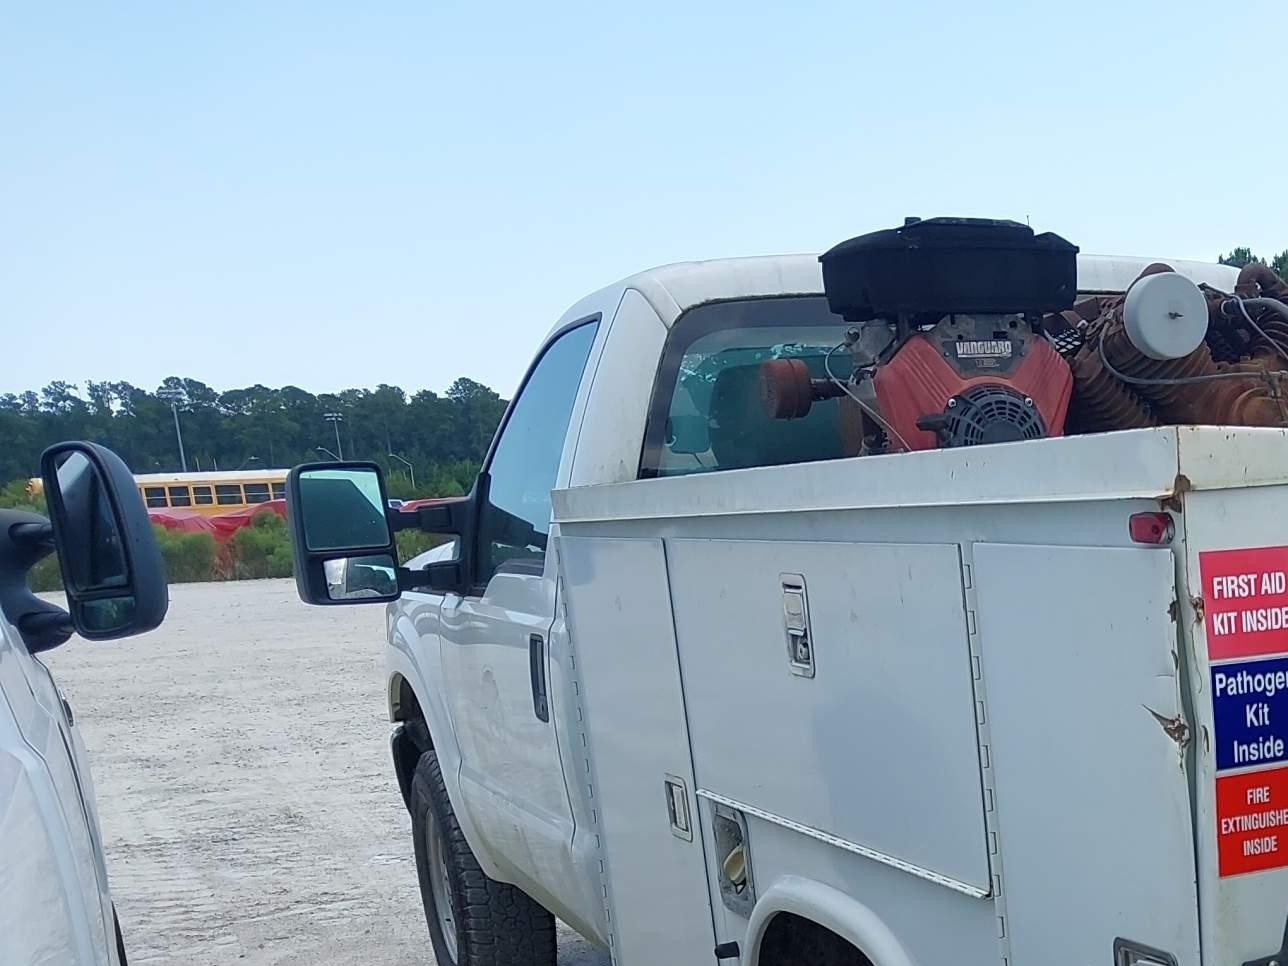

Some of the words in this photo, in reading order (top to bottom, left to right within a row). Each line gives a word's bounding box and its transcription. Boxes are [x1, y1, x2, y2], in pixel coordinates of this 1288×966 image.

[1213, 574, 1257, 600] FIRST
[1261, 571, 1286, 595] AID
[1213, 611, 1237, 636] KIT
[1246, 703, 1269, 727] Kit
[1233, 736, 1284, 763] Inside
[1246, 786, 1270, 804] FIRE
[1243, 839, 1278, 857] INSIDE
